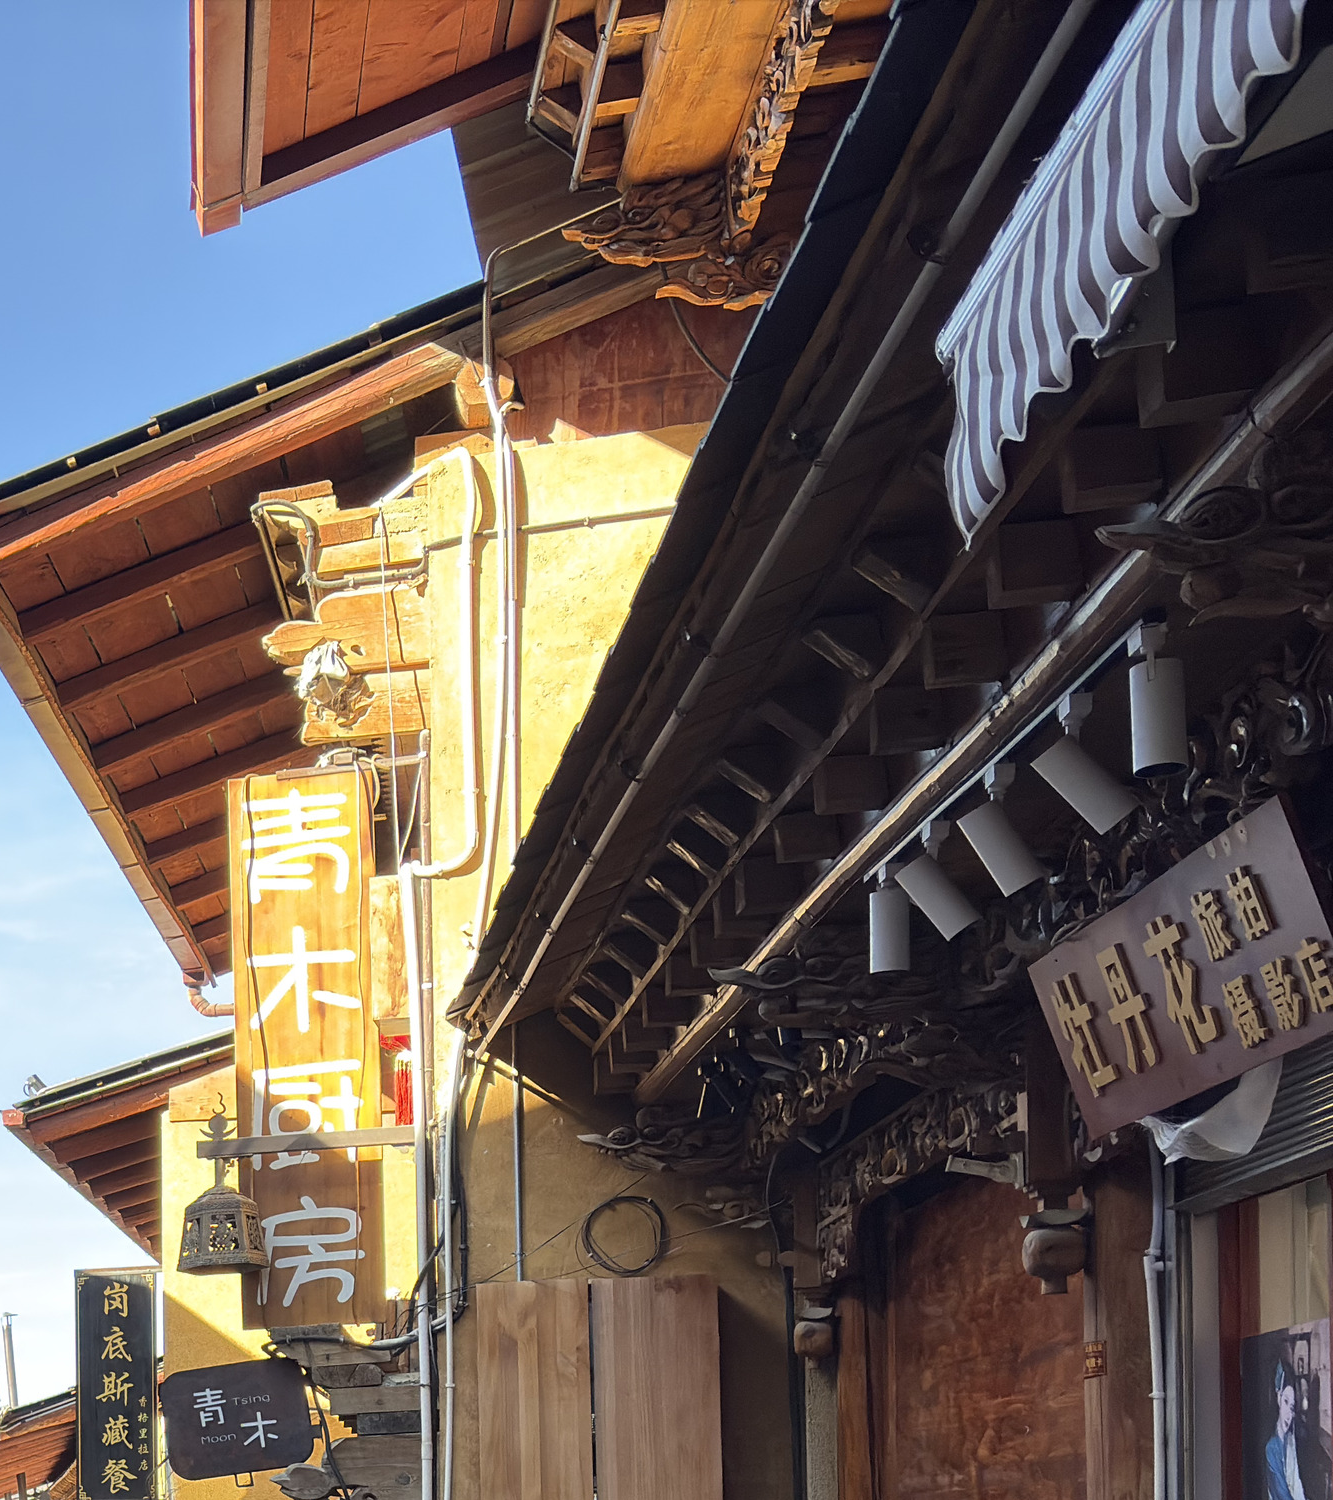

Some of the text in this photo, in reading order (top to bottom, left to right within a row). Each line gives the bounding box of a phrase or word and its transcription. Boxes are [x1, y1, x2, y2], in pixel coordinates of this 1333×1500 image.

[241, 787, 366, 1307] 青木厨房
[1050, 915, 1222, 1098] 牡丹花
[1221, 936, 1333, 1050] 摄影店
[95, 1281, 138, 1494] 岗底斯藏餐
[137, 1395, 149, 1473] 香格里拉店
[200, 1431, 237, 1446] Moon
[232, 1393, 271, 1407] Tsing
